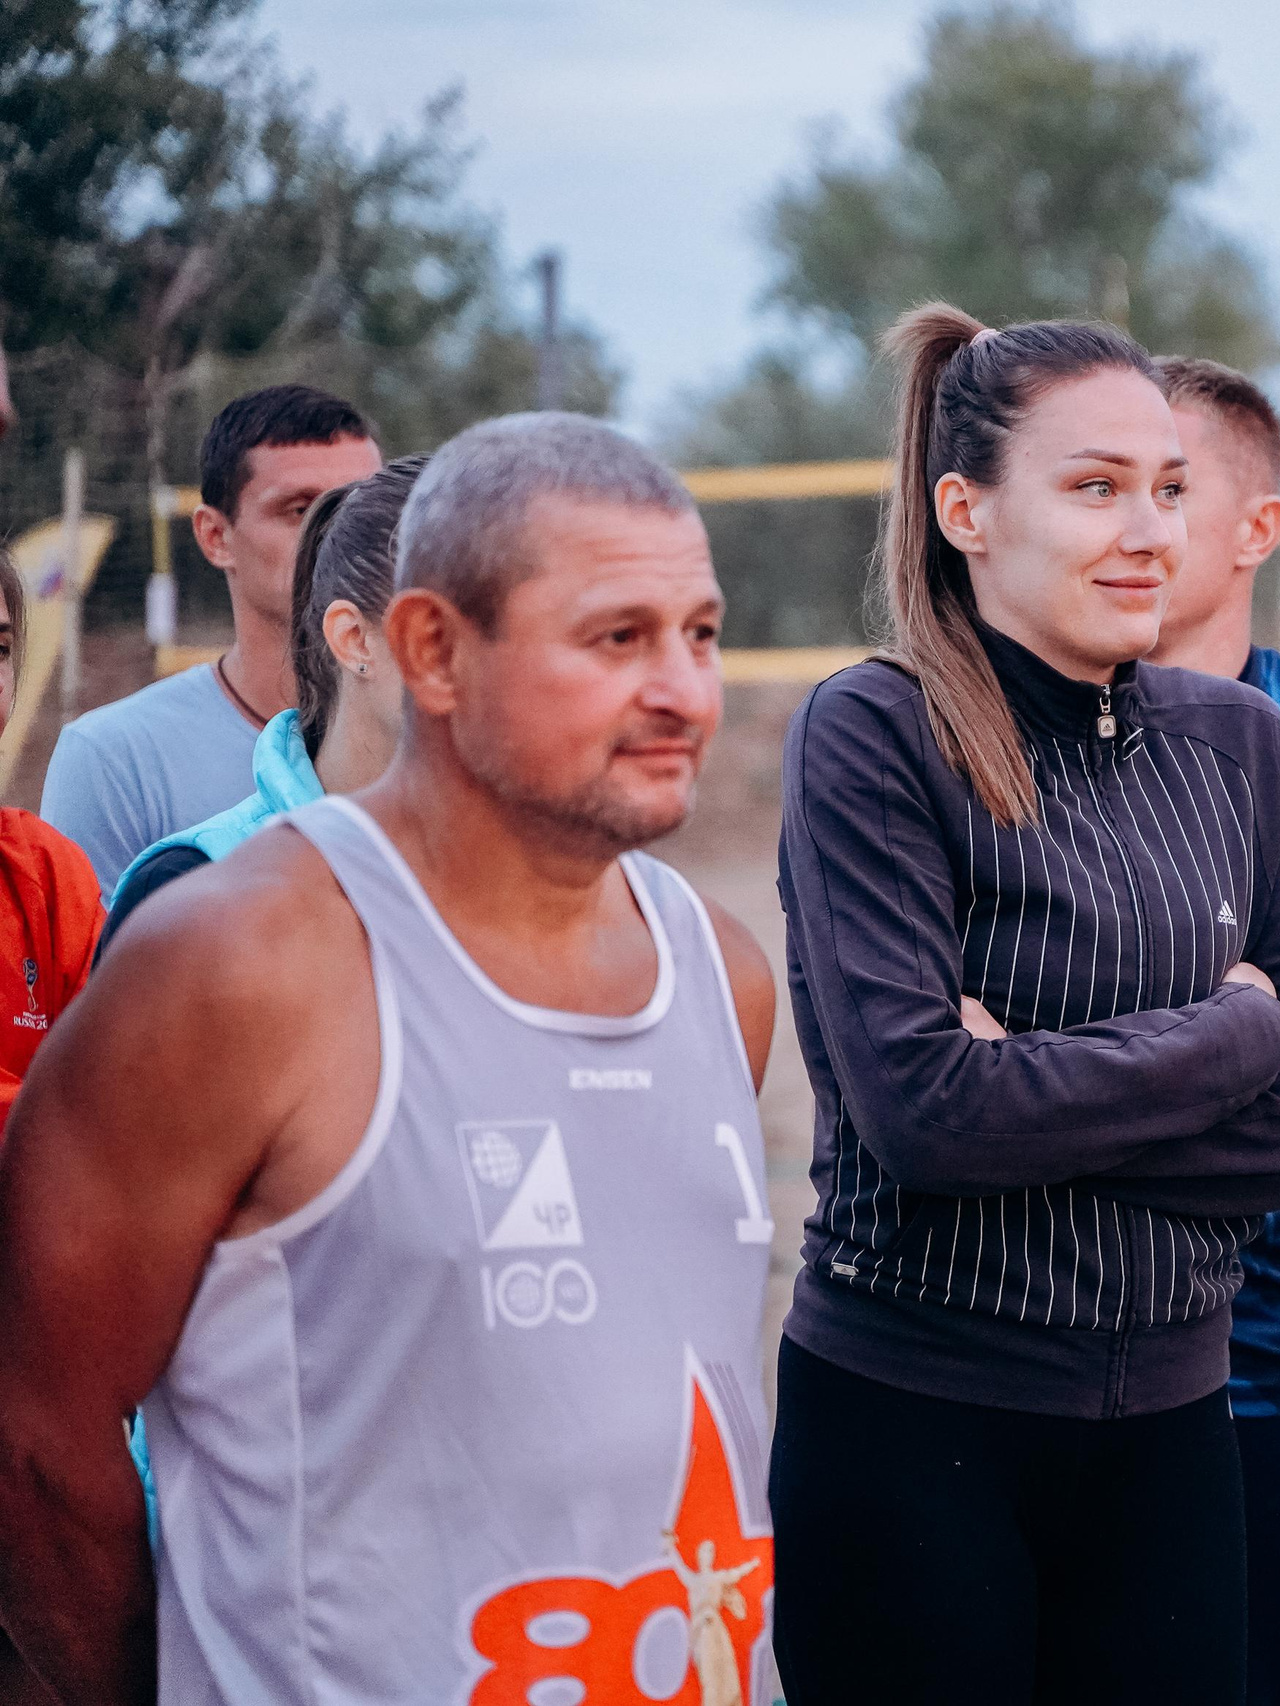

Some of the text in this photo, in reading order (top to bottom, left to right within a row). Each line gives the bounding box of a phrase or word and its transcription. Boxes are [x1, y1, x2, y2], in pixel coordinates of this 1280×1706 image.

[1217, 914, 1238, 926] adidas
[36, 1018, 48, 1030] 20
[714, 1122, 775, 1245] 1
